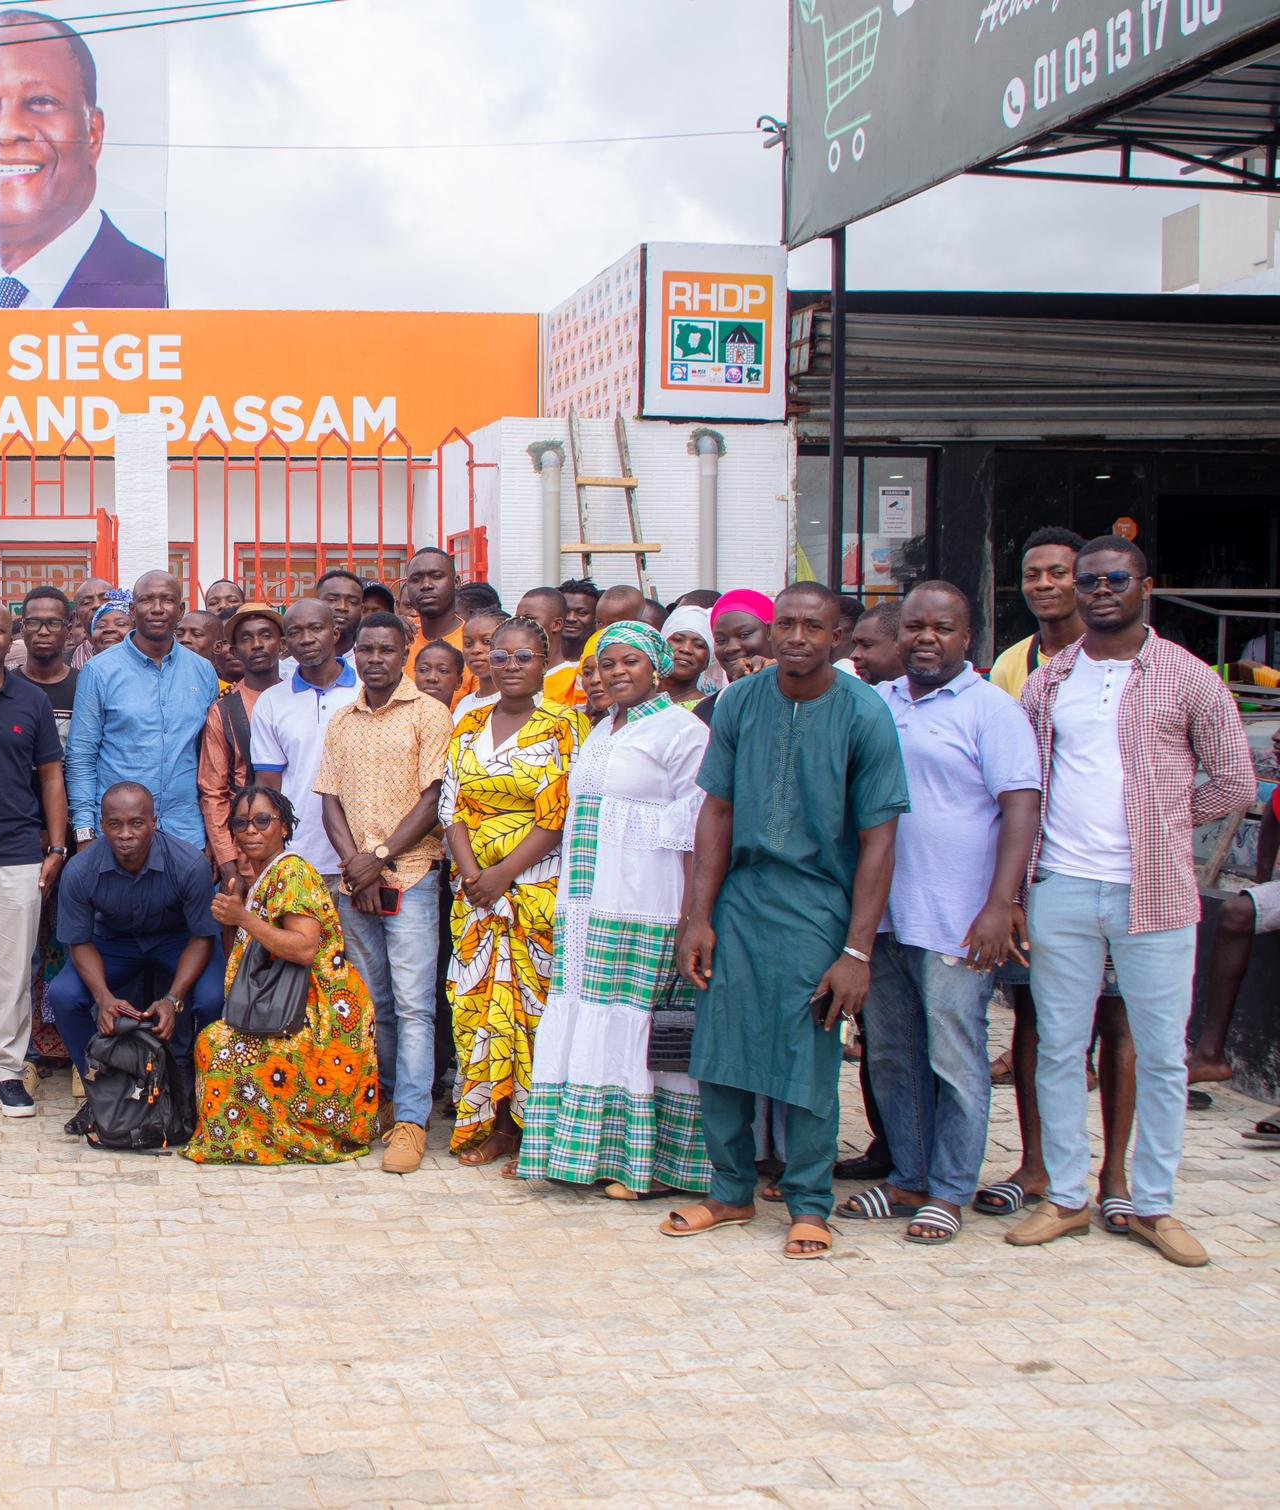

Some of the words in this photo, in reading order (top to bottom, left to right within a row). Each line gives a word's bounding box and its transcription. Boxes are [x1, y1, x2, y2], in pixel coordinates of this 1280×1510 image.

[1033, 47, 1057, 110] 01
[1065, 27, 1098, 95] 03
[1106, 8, 1133, 74] 13
[1141, 0, 1169, 56] 17
[669, 281, 766, 313] RHDP
[7, 320, 182, 381] SIÈGE
[148, 395, 397, 442] BASSAM
